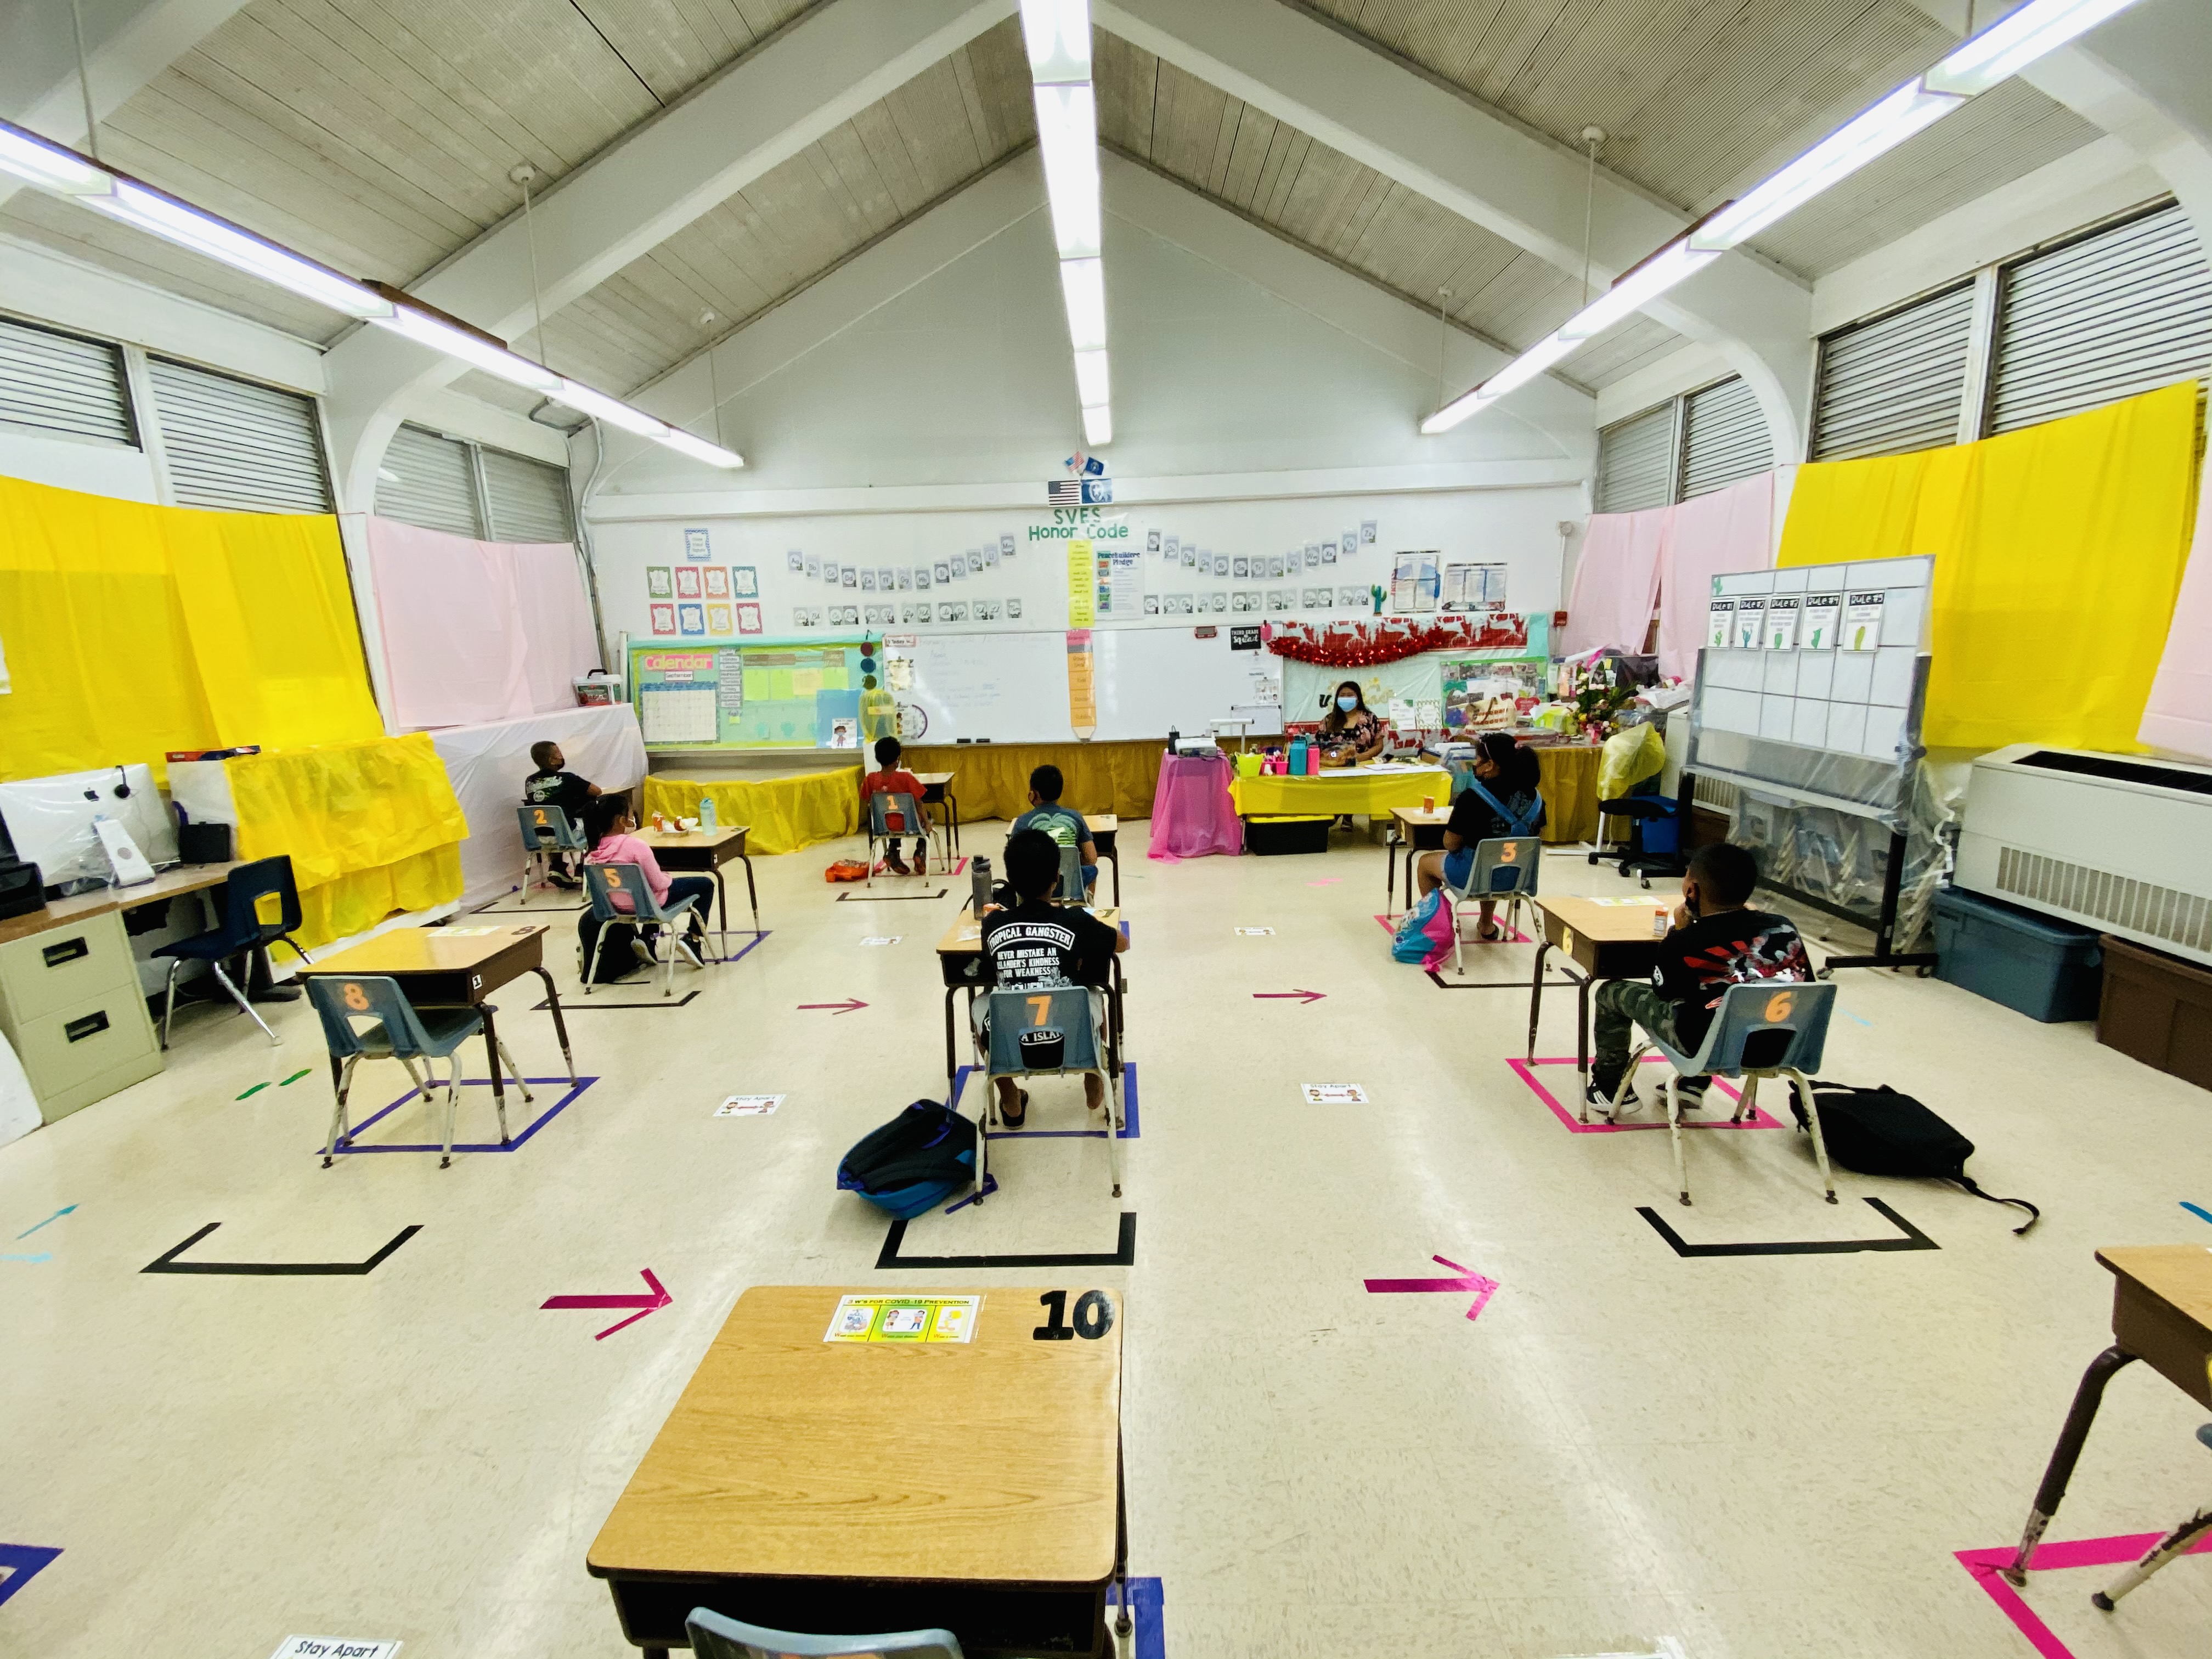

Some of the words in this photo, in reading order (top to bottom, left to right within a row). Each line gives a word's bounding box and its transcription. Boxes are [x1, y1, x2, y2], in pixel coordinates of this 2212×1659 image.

[1054, 507, 1101, 524] SVES
[1029, 526, 1077, 541] Honor
[1087, 523, 1128, 539] Code
[1233, 635, 1258, 645] Squad
[645, 654, 712, 670] Calendar
[887, 795, 899, 810] 1
[533, 809, 547, 825] 2
[604, 868, 622, 888] 5
[990, 927, 1022, 949] TROPICAL
[1025, 927, 1071, 945] GANGSTER
[997, 950, 1014, 960] NEVER
[1017, 948, 1045, 958] MISTAKE
[1047, 947, 1057, 956] AN
[997, 959, 1026, 970] ISLANDER'S
[1029, 957, 1060, 967] KINDNESS
[1003, 969, 1013, 978] FOR
[1015, 967, 1052, 977] WEAKNESS
[344, 983, 369, 1011] 8
[1027, 995, 1052, 1026] 7
[1765, 991, 1792, 1023] 6
[1033, 1290, 1116, 1340] 10
[295, 1641, 331, 1658] Stay
[331, 1644, 379, 1659] Apart
